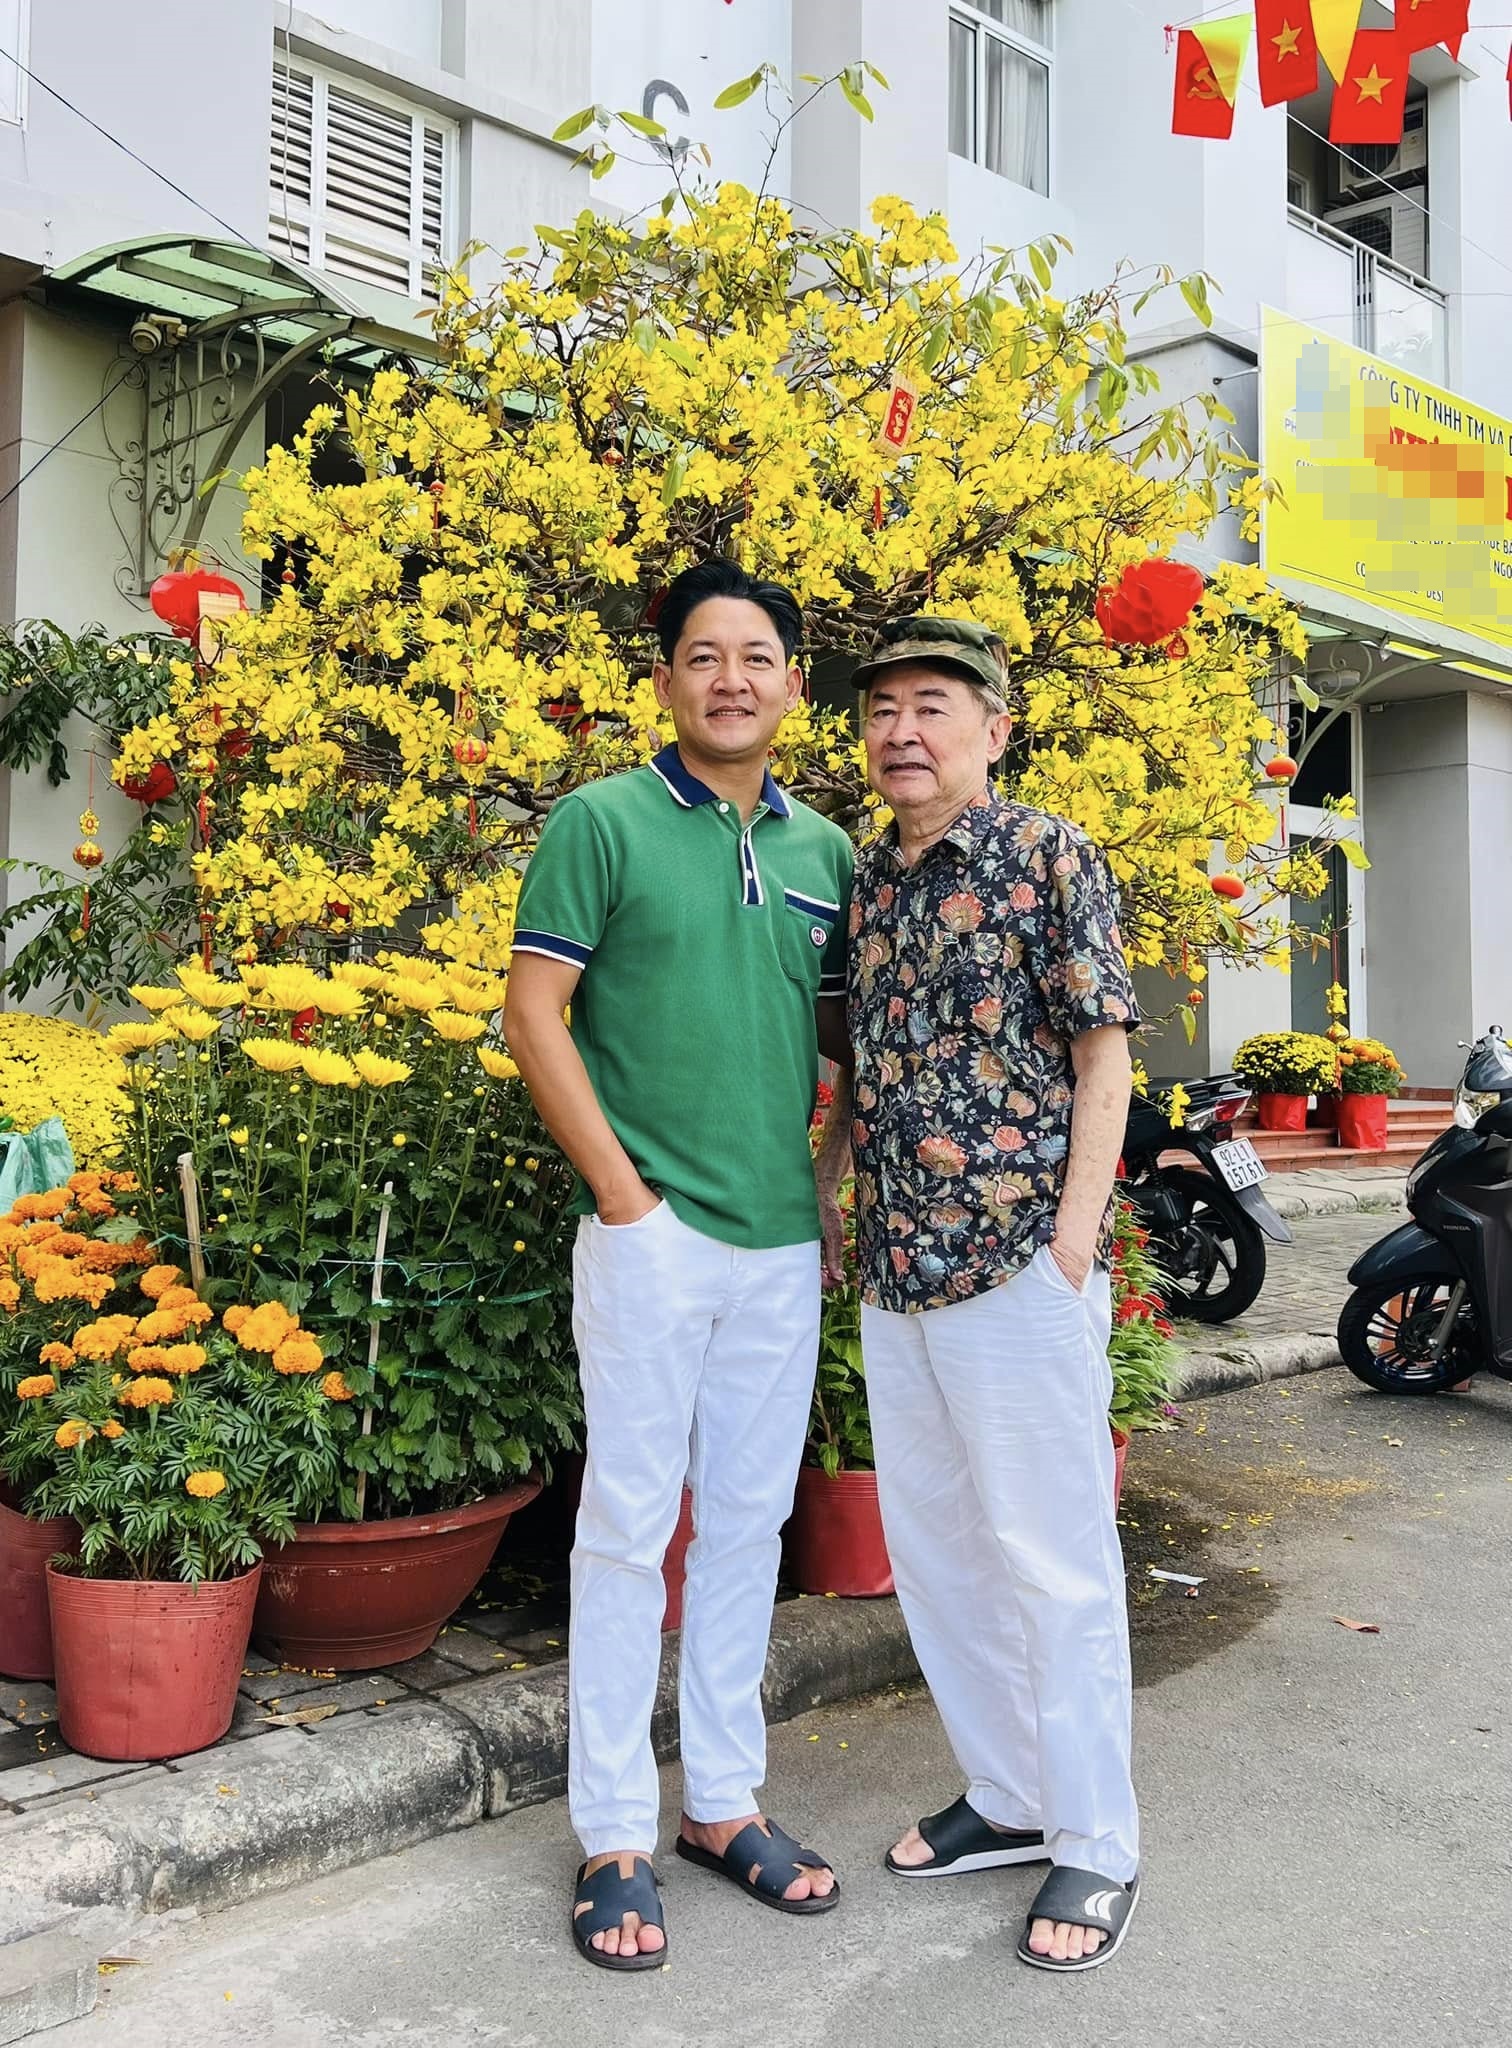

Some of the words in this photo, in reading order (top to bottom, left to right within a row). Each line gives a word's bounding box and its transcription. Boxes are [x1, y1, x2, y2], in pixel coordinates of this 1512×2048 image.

[1403, 385, 1420, 413] TY
[1425, 395, 1462, 432] TNHH
[1466, 414, 1485, 443] TM
[1220, 1143, 1251, 1167] 92-L1
